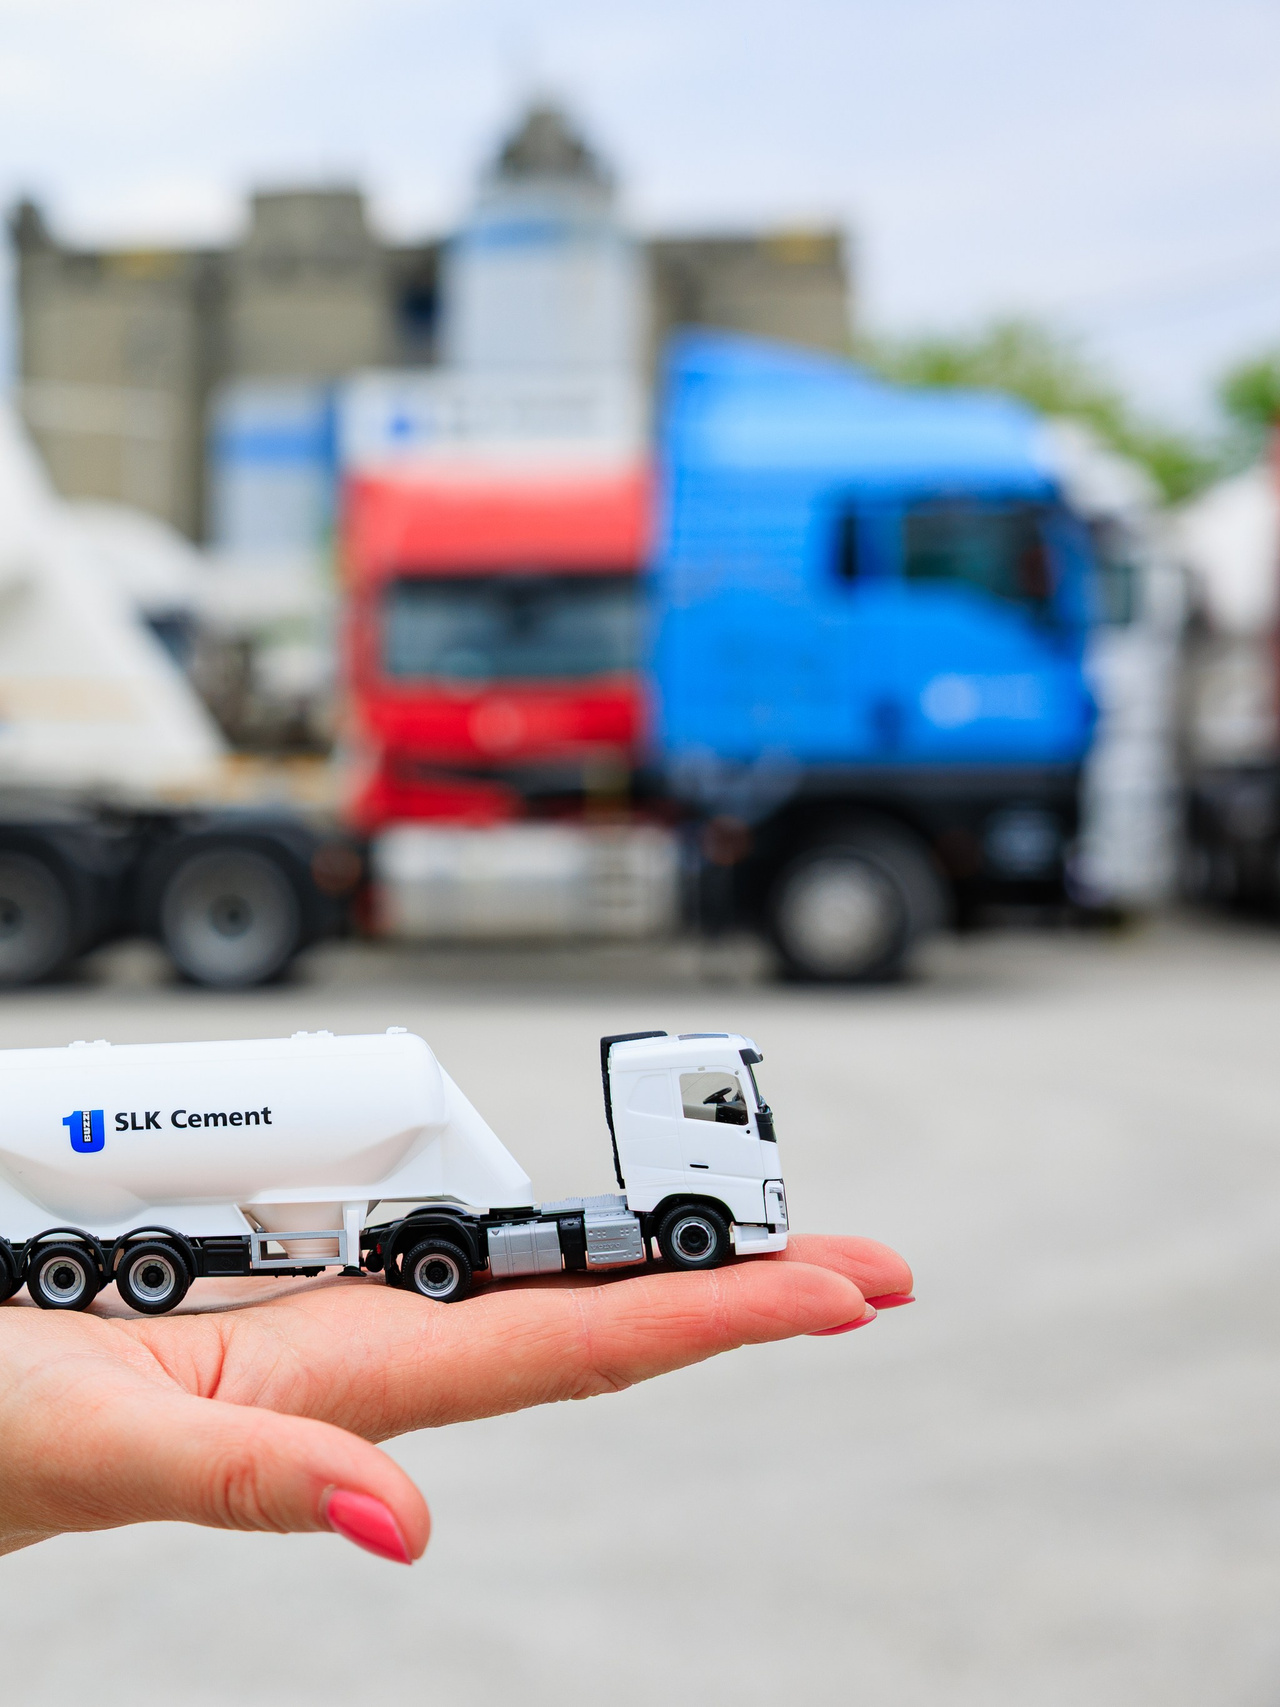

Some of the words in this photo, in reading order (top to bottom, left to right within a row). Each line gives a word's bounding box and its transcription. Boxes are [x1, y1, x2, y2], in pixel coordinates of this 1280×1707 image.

[82, 1111, 92, 1142] BUZZI
[114, 1110, 162, 1131] SLK
[170, 1106, 272, 1129] Cement
